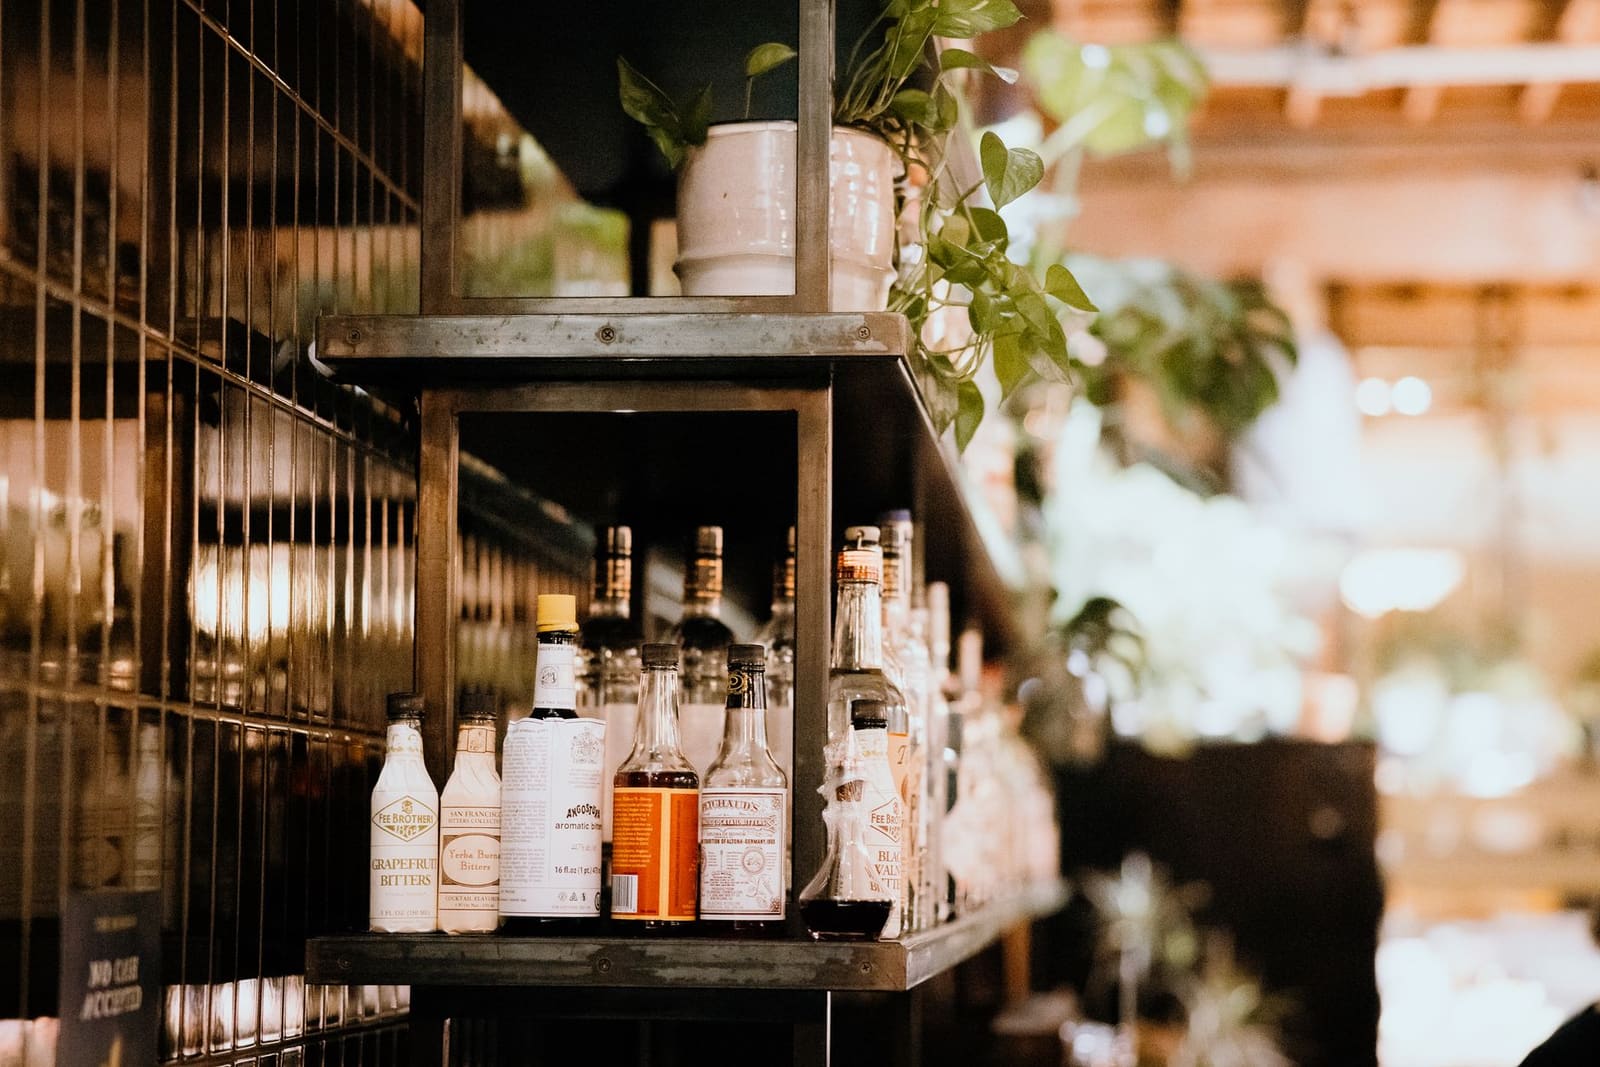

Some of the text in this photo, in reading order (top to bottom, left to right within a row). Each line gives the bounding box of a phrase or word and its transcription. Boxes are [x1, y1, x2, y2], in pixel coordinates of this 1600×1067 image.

[378, 813, 391, 823] FEE
[871, 813, 885, 824] FEE
[555, 822, 590, 830] aromatic
[554, 866, 563, 874] 16
[380, 874, 431, 887] BITTERS
